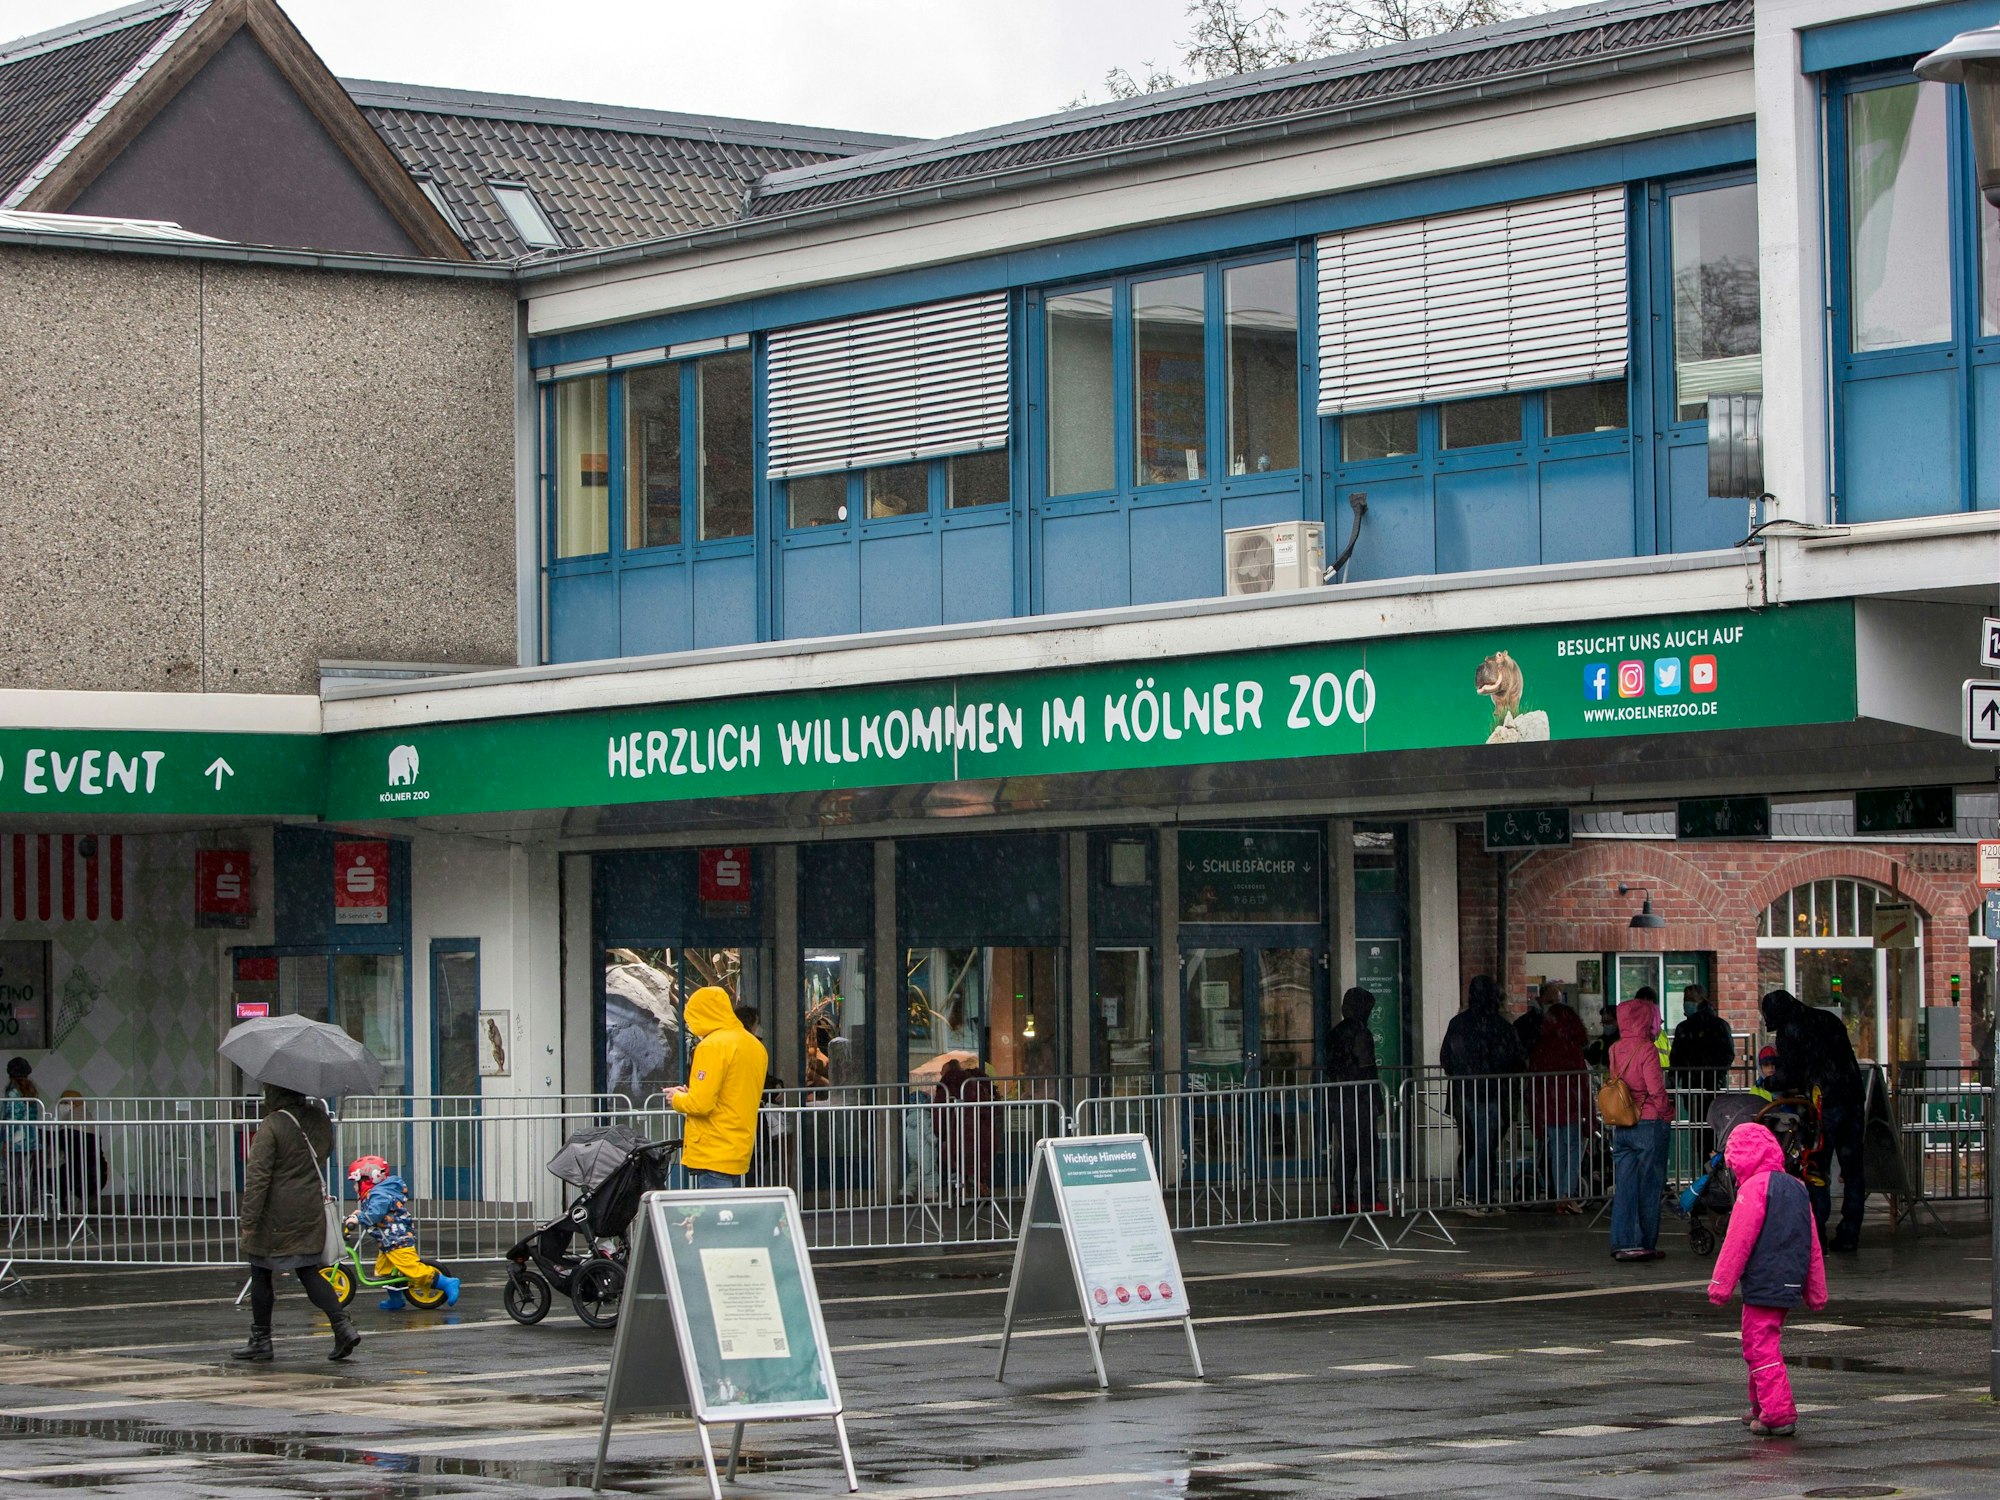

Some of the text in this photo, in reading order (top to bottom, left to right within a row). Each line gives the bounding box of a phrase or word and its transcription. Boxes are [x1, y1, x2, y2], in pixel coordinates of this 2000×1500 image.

[1557, 626, 1744, 657] BESUCHT UNS AUCH AUF
[608, 669, 1376, 778] HERZLICH WILLKOMMEN IM KÖLNER ZOO
[1584, 701, 1718, 723] WWW.KOELNERZOO.DE
[24, 749, 165, 795] EVENT
[380, 790, 430, 802] KÖLNER ZOO
[1062, 1150, 1137, 1165] Wichtige Hinweise
